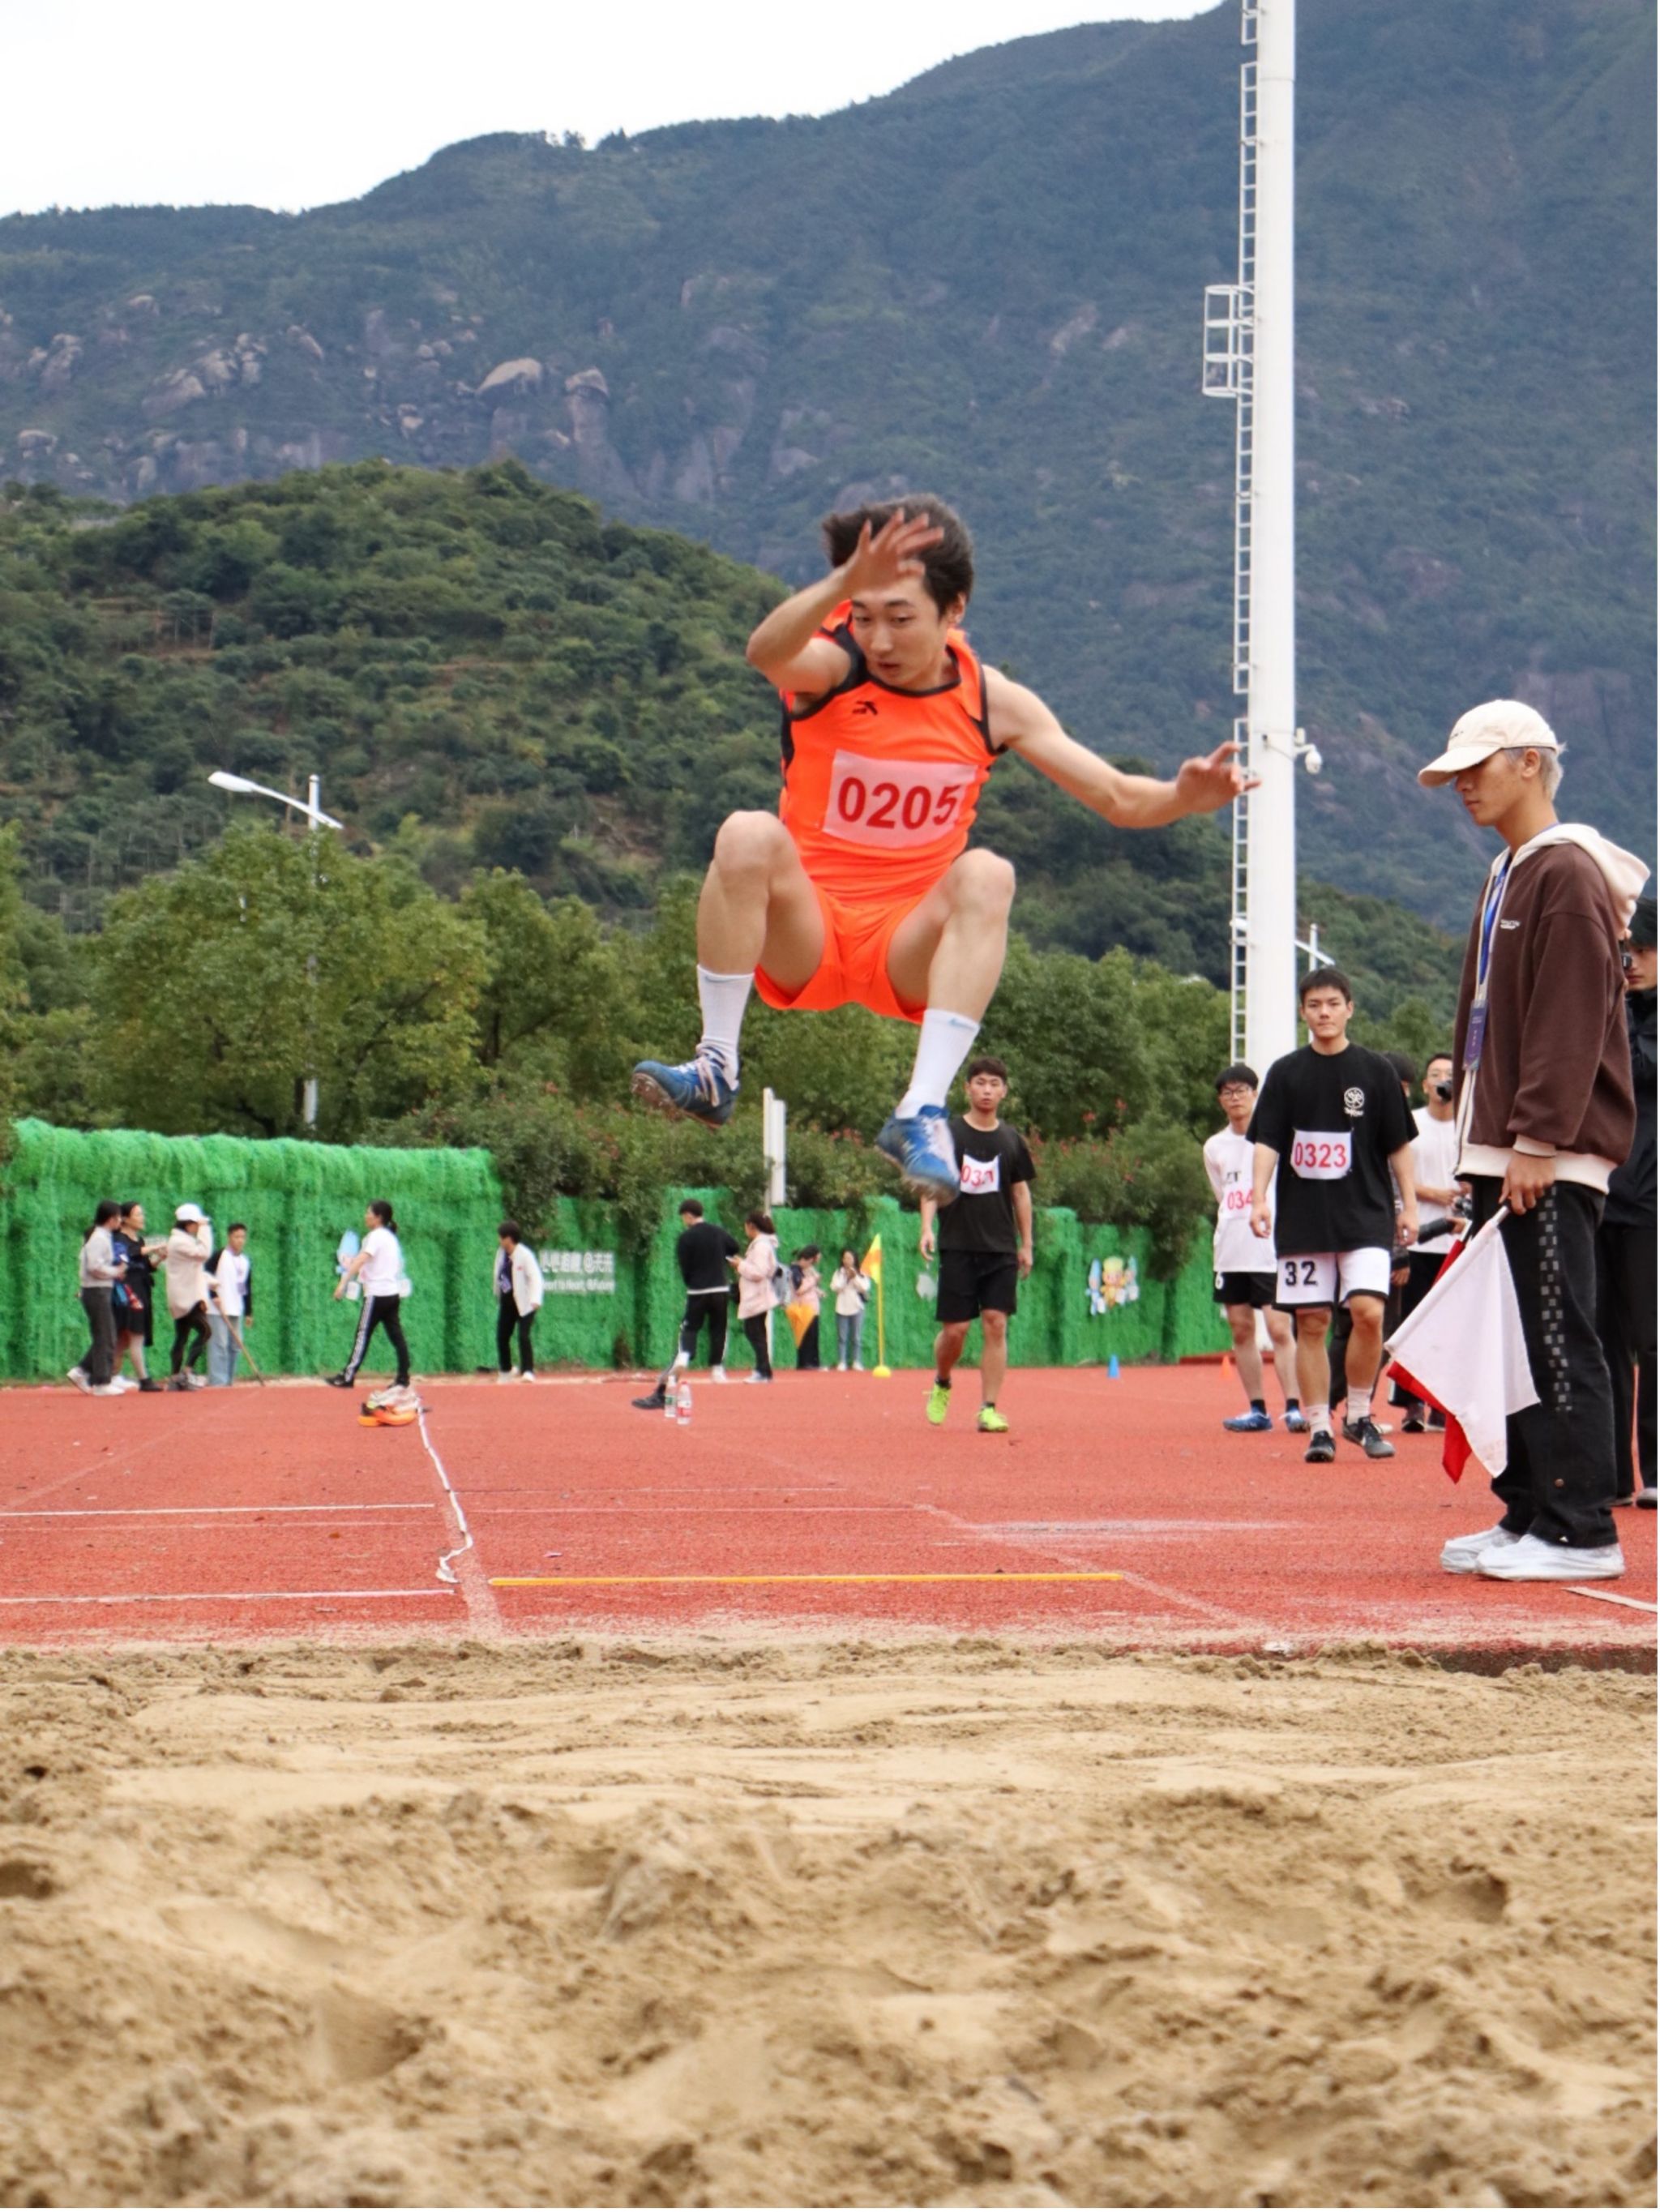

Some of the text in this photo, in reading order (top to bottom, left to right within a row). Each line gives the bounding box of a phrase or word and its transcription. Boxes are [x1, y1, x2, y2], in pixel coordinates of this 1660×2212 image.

[838, 777, 961, 830] 0205
[1294, 1141, 1347, 1169] 0323
[1227, 1188, 1256, 1210] 034
[1285, 1260, 1319, 1286] 32
